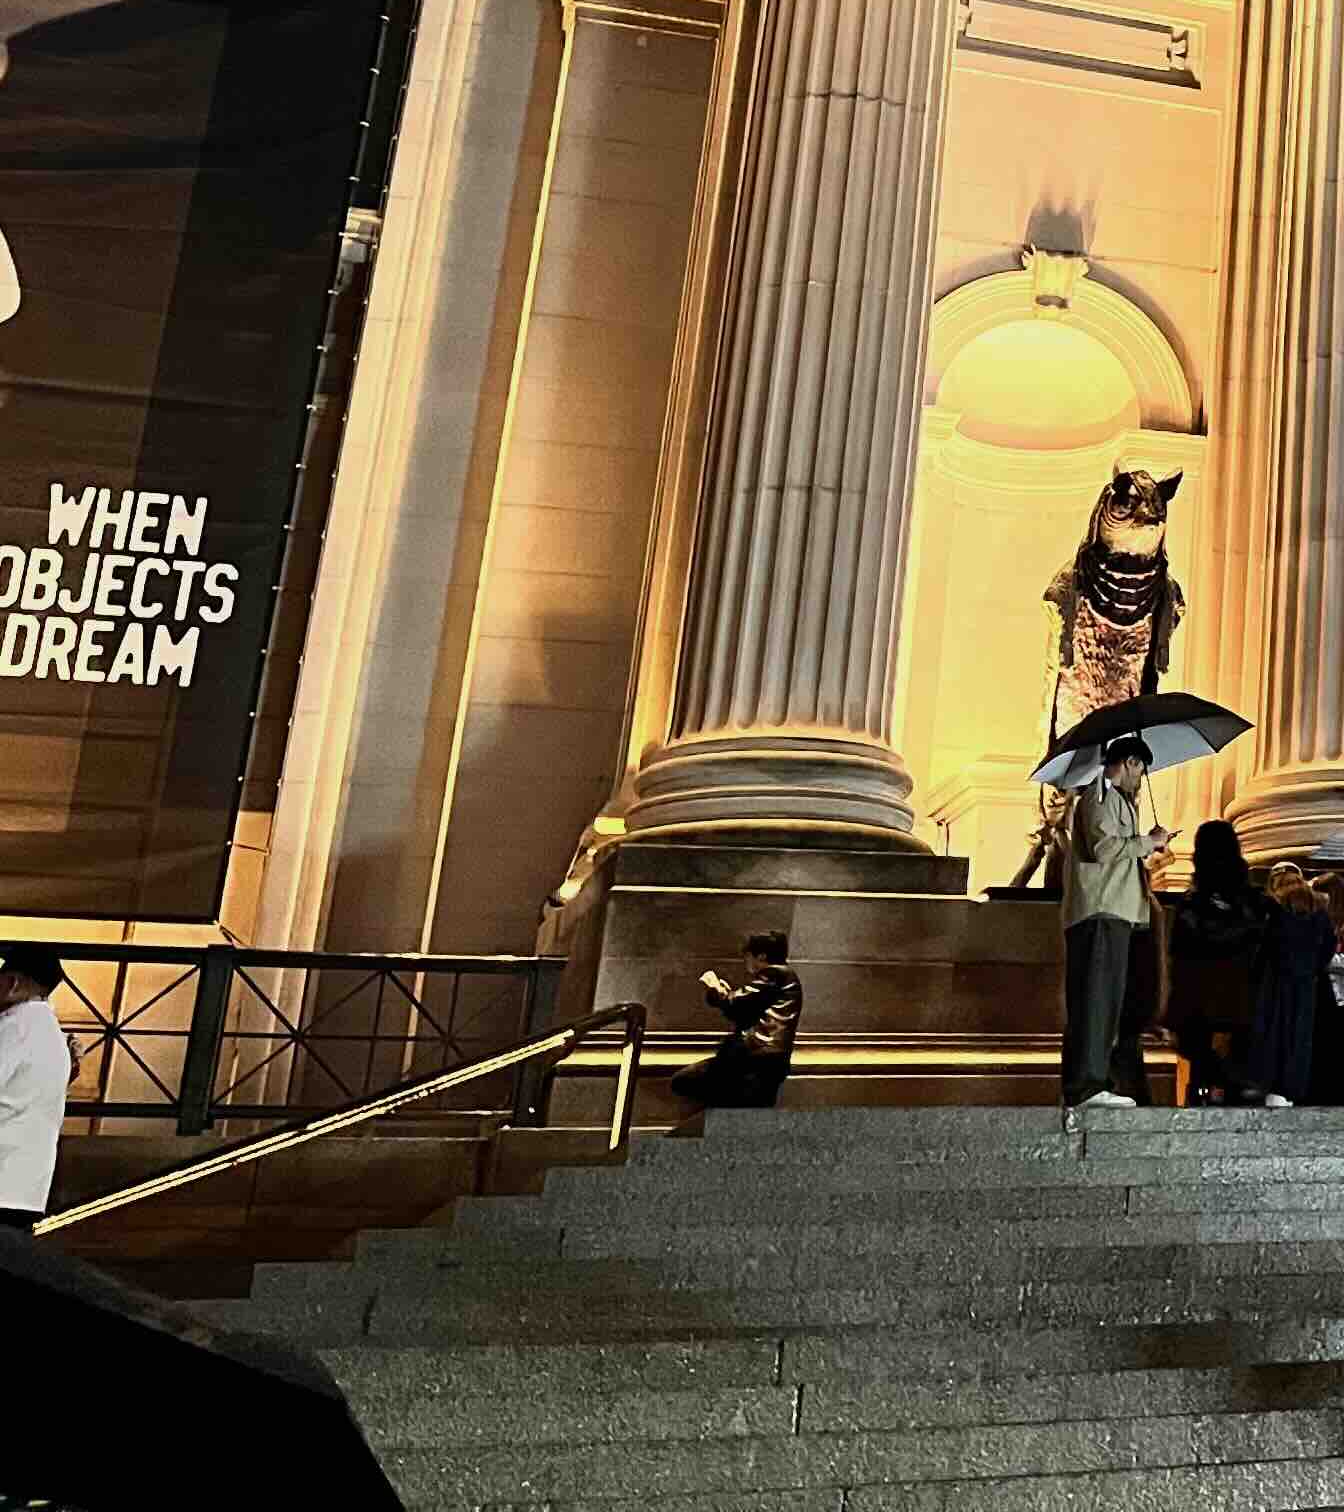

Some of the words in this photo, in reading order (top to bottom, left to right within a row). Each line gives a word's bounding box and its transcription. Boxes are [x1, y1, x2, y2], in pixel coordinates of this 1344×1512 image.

[48, 483, 208, 556] WHEN
[0, 545, 239, 623] OBJECTS
[0, 613, 200, 687] DREAM
